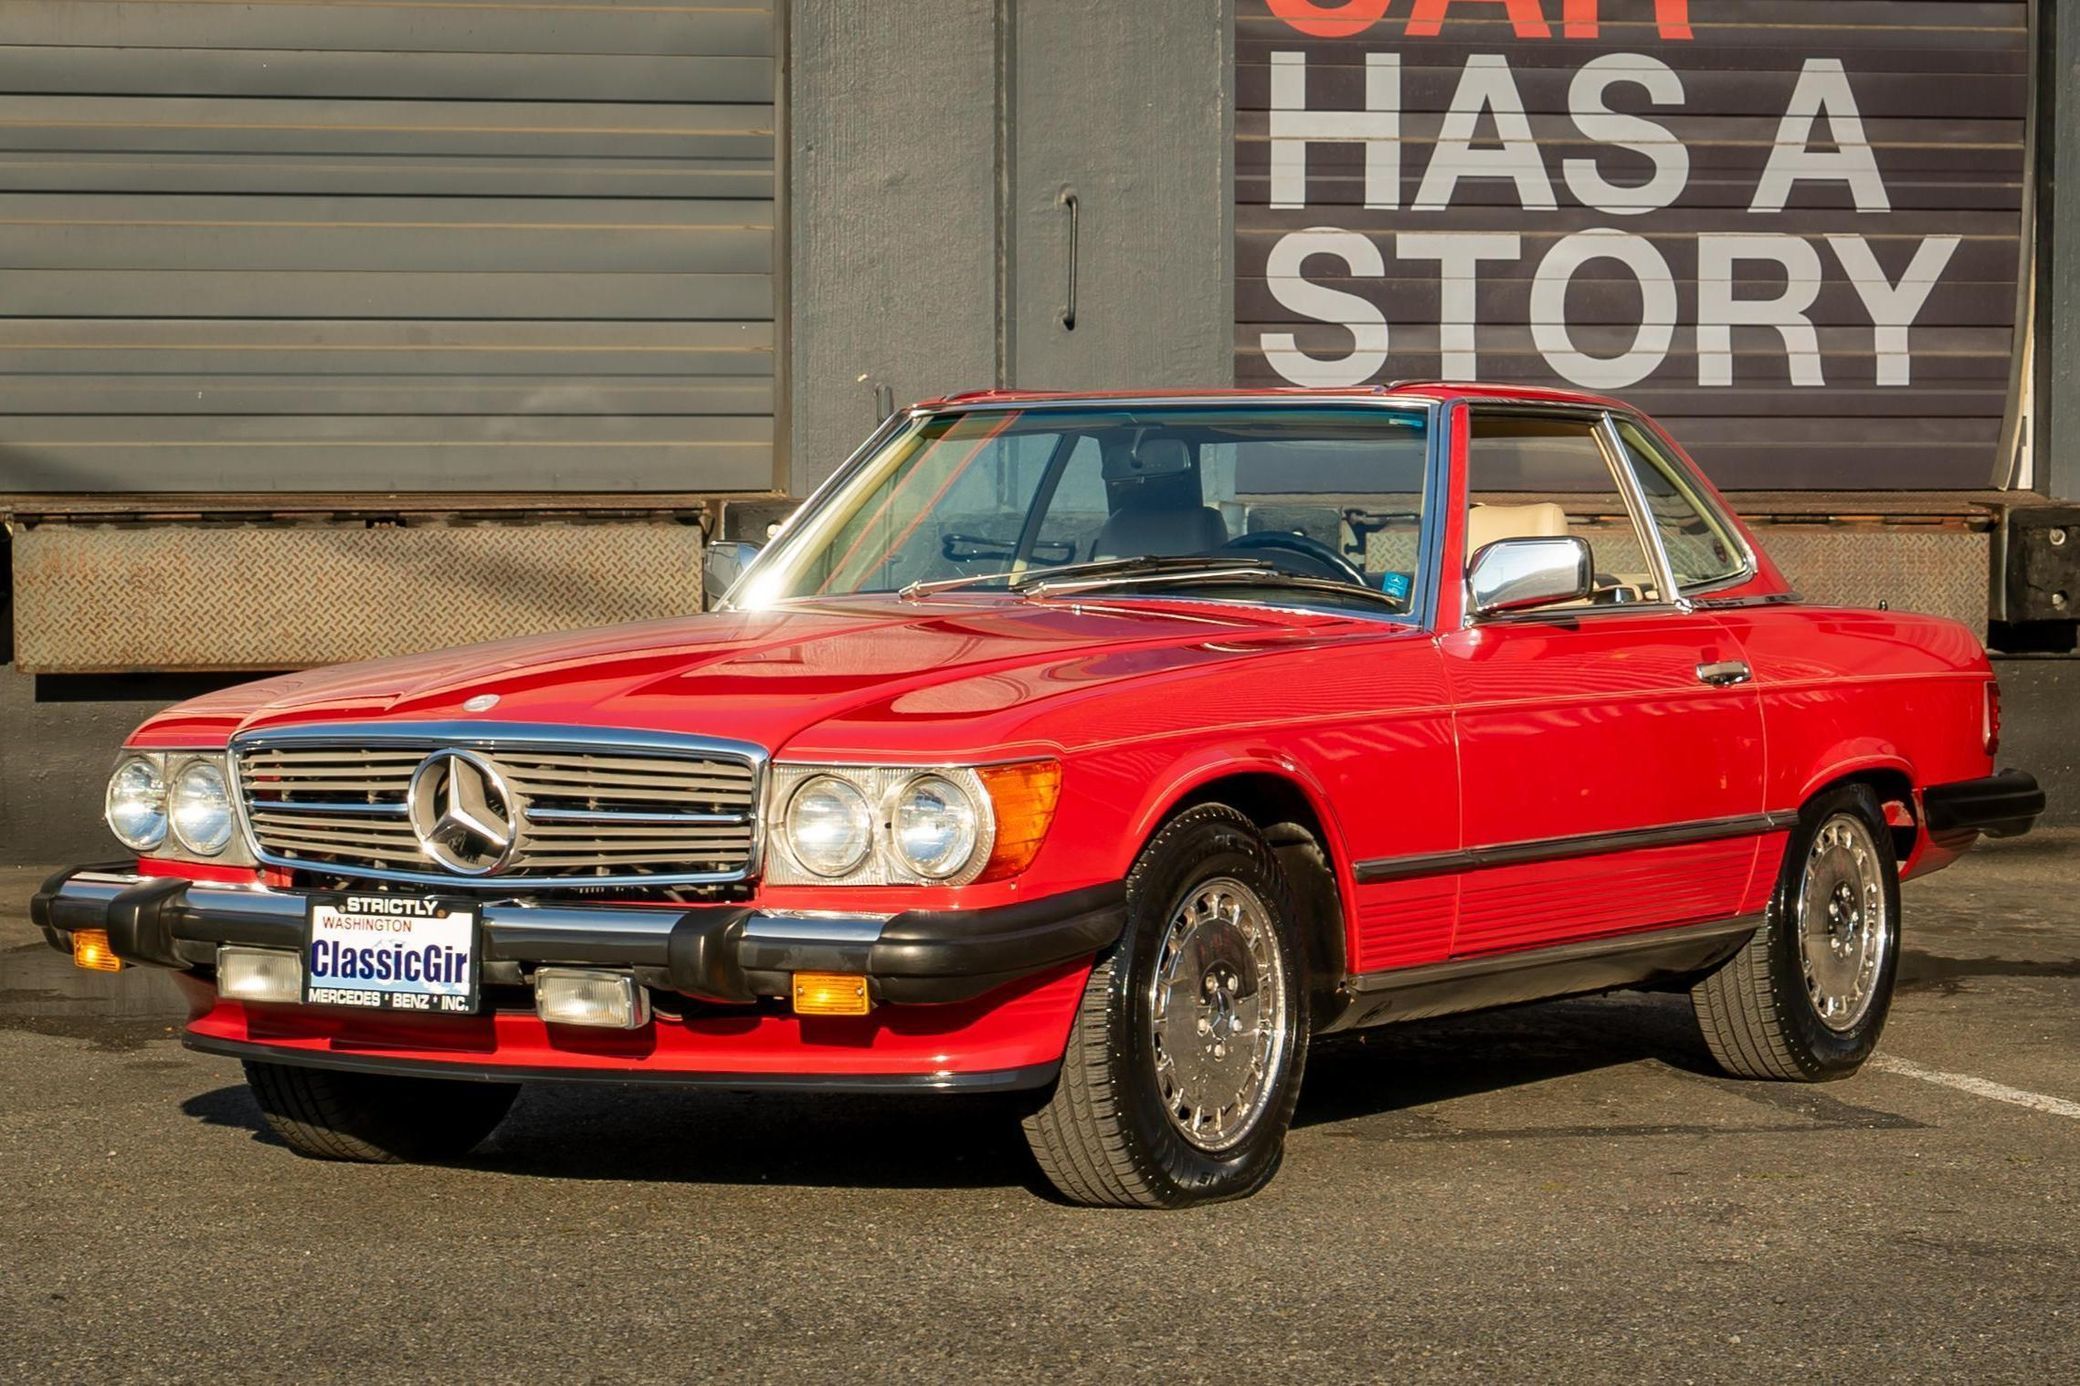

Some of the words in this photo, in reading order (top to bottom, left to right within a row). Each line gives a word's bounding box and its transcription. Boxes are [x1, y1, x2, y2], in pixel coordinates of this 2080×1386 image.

[1269, 51, 1690, 216] HAS
[1746, 58, 1892, 214] A
[1259, 226, 1964, 389] STORY
[347, 896, 439, 916] STRICTLY
[322, 916, 413, 933] WASHINGTON
[310, 939, 473, 984] ClassicGir
[308, 988, 381, 1007] MERCEDES
[392, 993, 430, 1010] BENZ
[441, 996, 470, 1012] INC.
